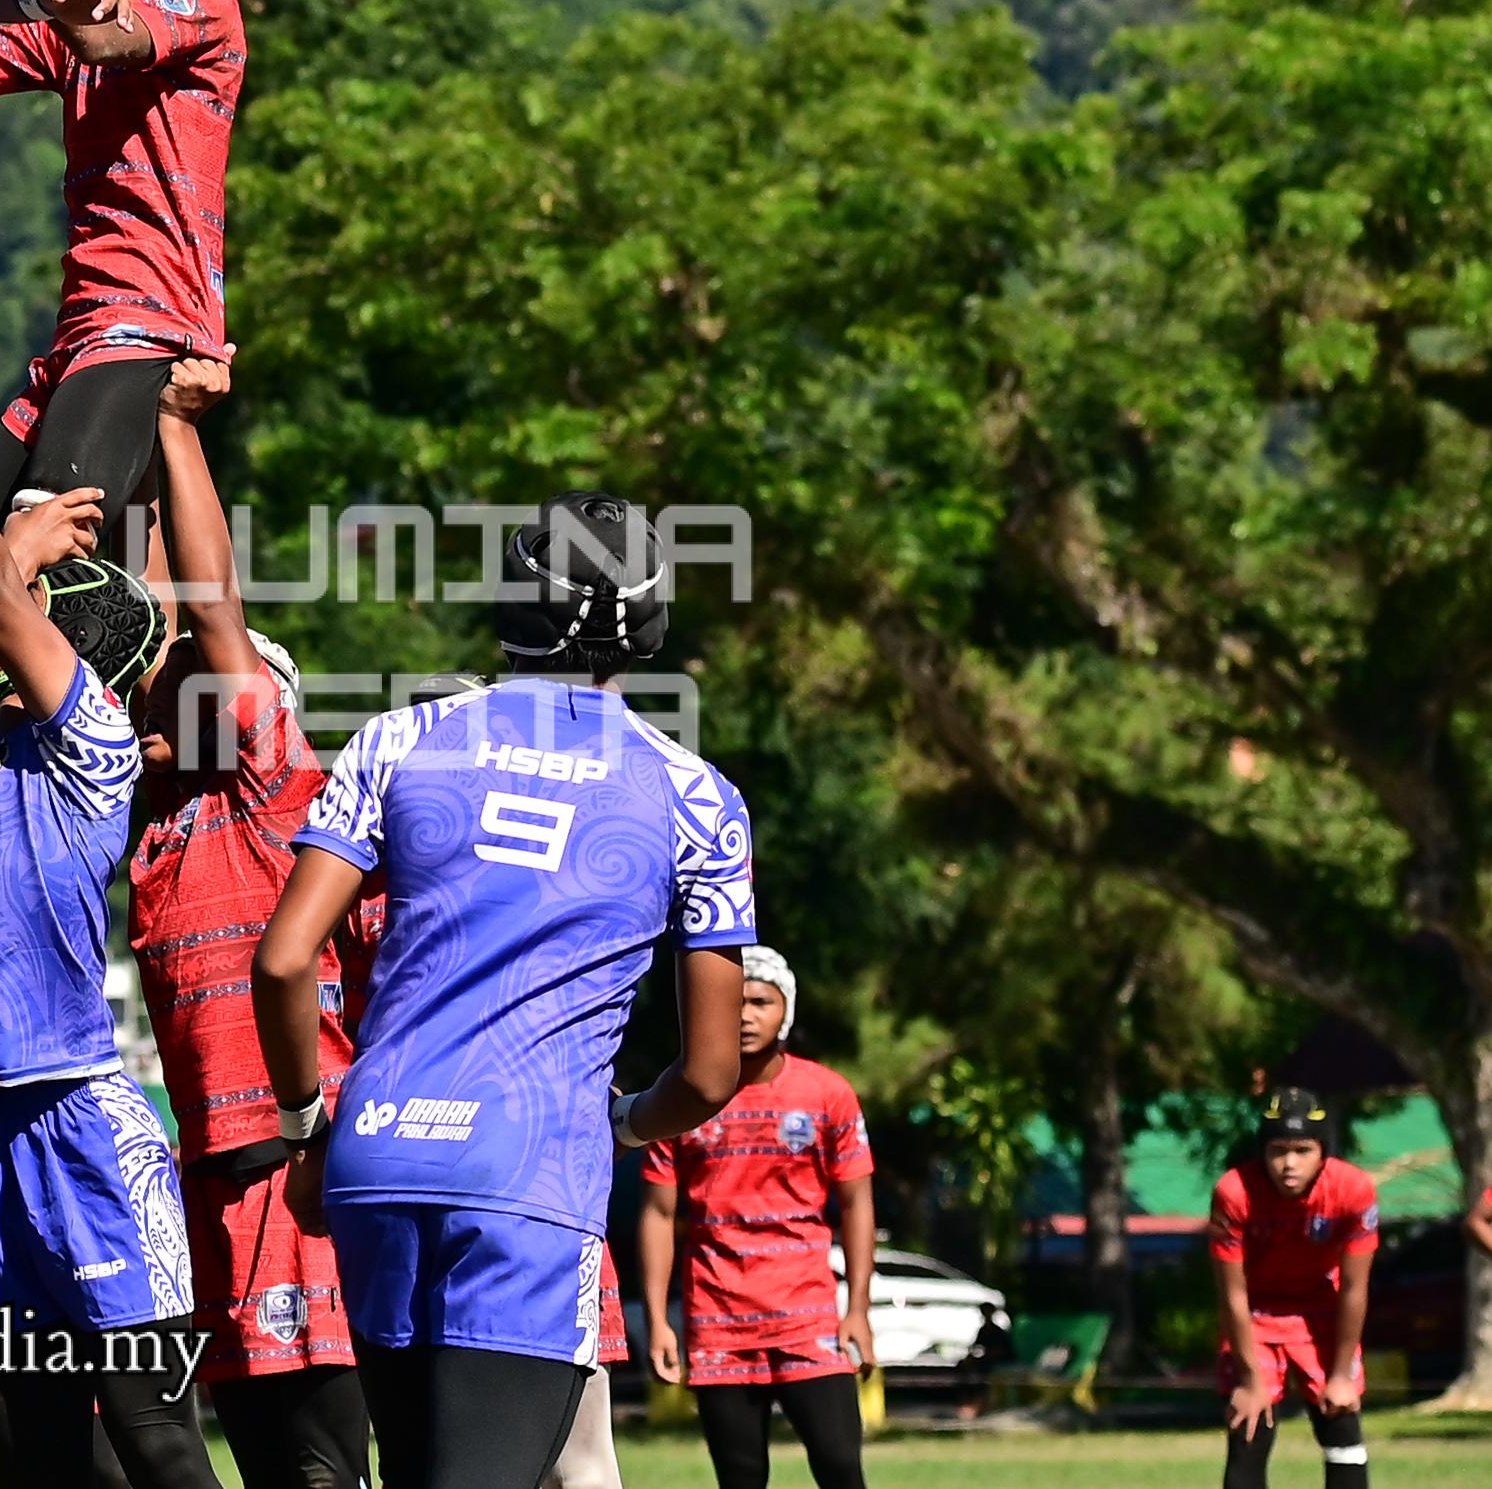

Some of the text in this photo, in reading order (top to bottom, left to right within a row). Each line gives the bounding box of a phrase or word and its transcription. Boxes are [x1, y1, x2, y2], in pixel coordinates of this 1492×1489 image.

[474, 740, 609, 784] HSBP
[473, 790, 577, 873] 9
[73, 1258, 126, 1281] HSBP
